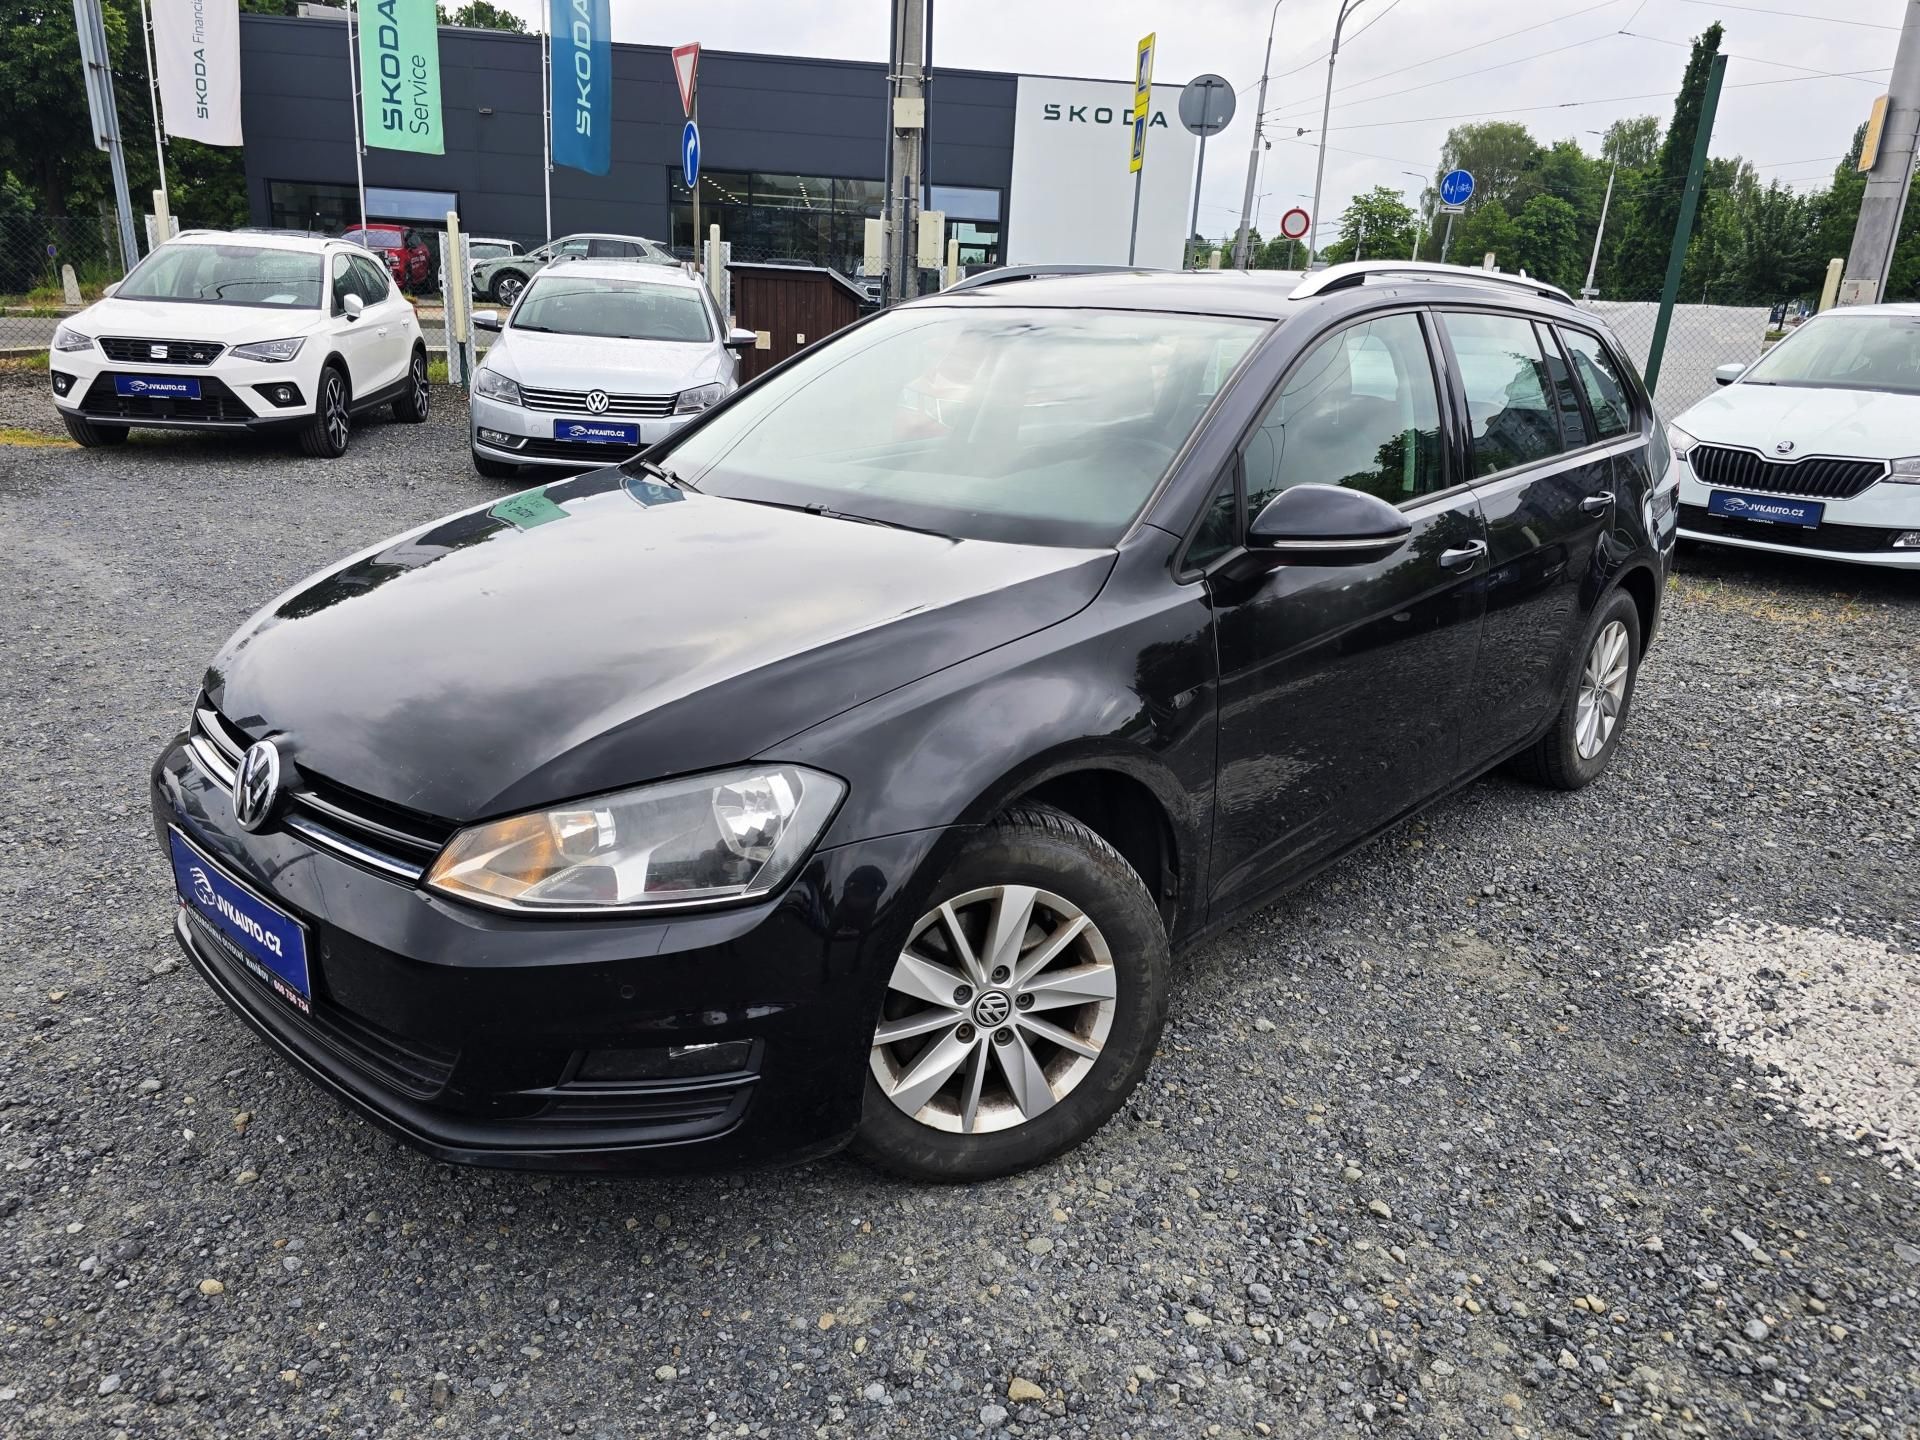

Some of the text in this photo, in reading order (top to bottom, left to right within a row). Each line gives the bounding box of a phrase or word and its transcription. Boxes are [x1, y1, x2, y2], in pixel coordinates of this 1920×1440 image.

[192, 0, 205, 44] Financi
[408, 54, 430, 136] Service
[148, 383, 187, 391] JVKAUTO.CZ
[587, 428, 625, 438] JVKAUTO.CZ
[1748, 503, 1805, 517] JVKAUTO.CZ
[215, 894, 283, 958] JVKAUTO.CZ
